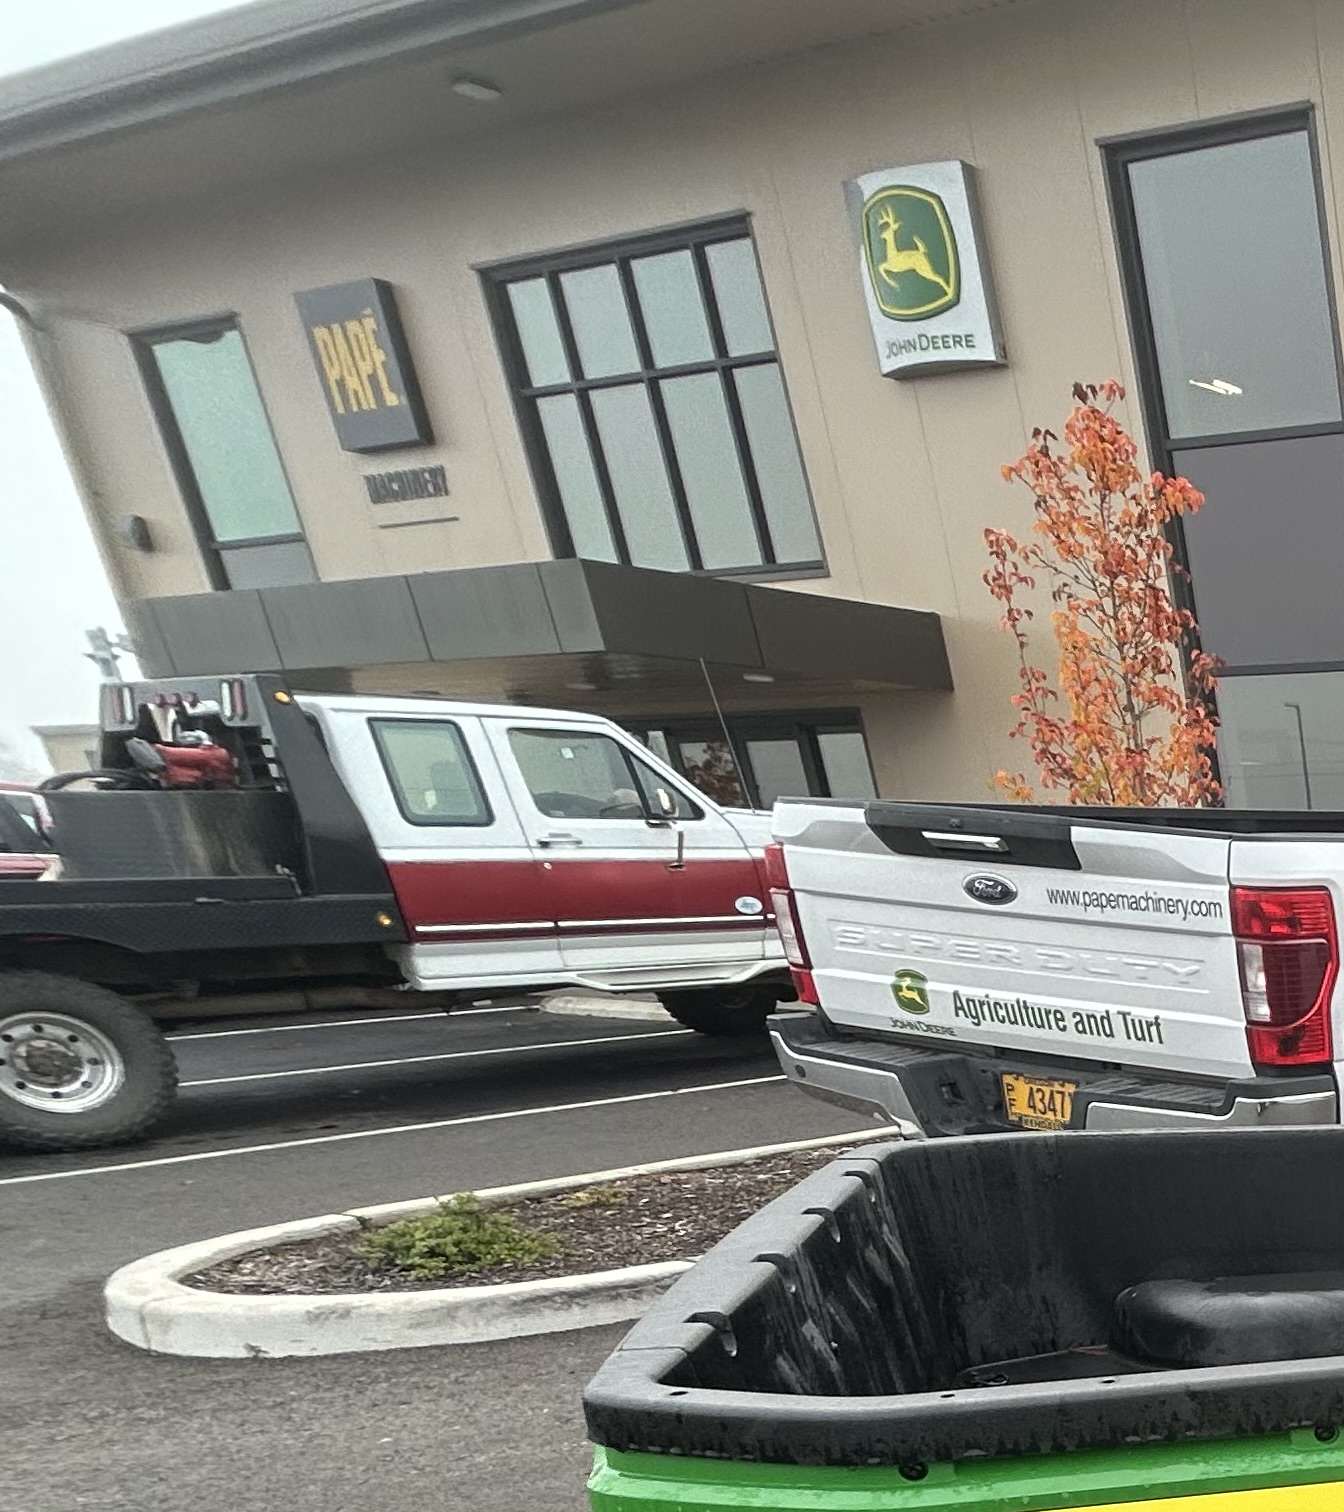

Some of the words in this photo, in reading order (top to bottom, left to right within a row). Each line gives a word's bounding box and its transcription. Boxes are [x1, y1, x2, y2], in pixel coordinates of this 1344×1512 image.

[886, 337, 917, 359] JOHN
[918, 333, 977, 353] DEERE
[973, 878, 1003, 899] Ford
[1046, 888, 1223, 921] www.papemachinery.com
[835, 926, 1022, 965] SUPER
[1035, 948, 1201, 986] DUTY
[919, 1020, 958, 1037] DEERE
[953, 990, 1068, 1033] Agriculture
[1072, 1009, 1115, 1039] and
[1117, 1009, 1164, 1045] Turf
[1027, 1085, 1067, 1119] 4347
